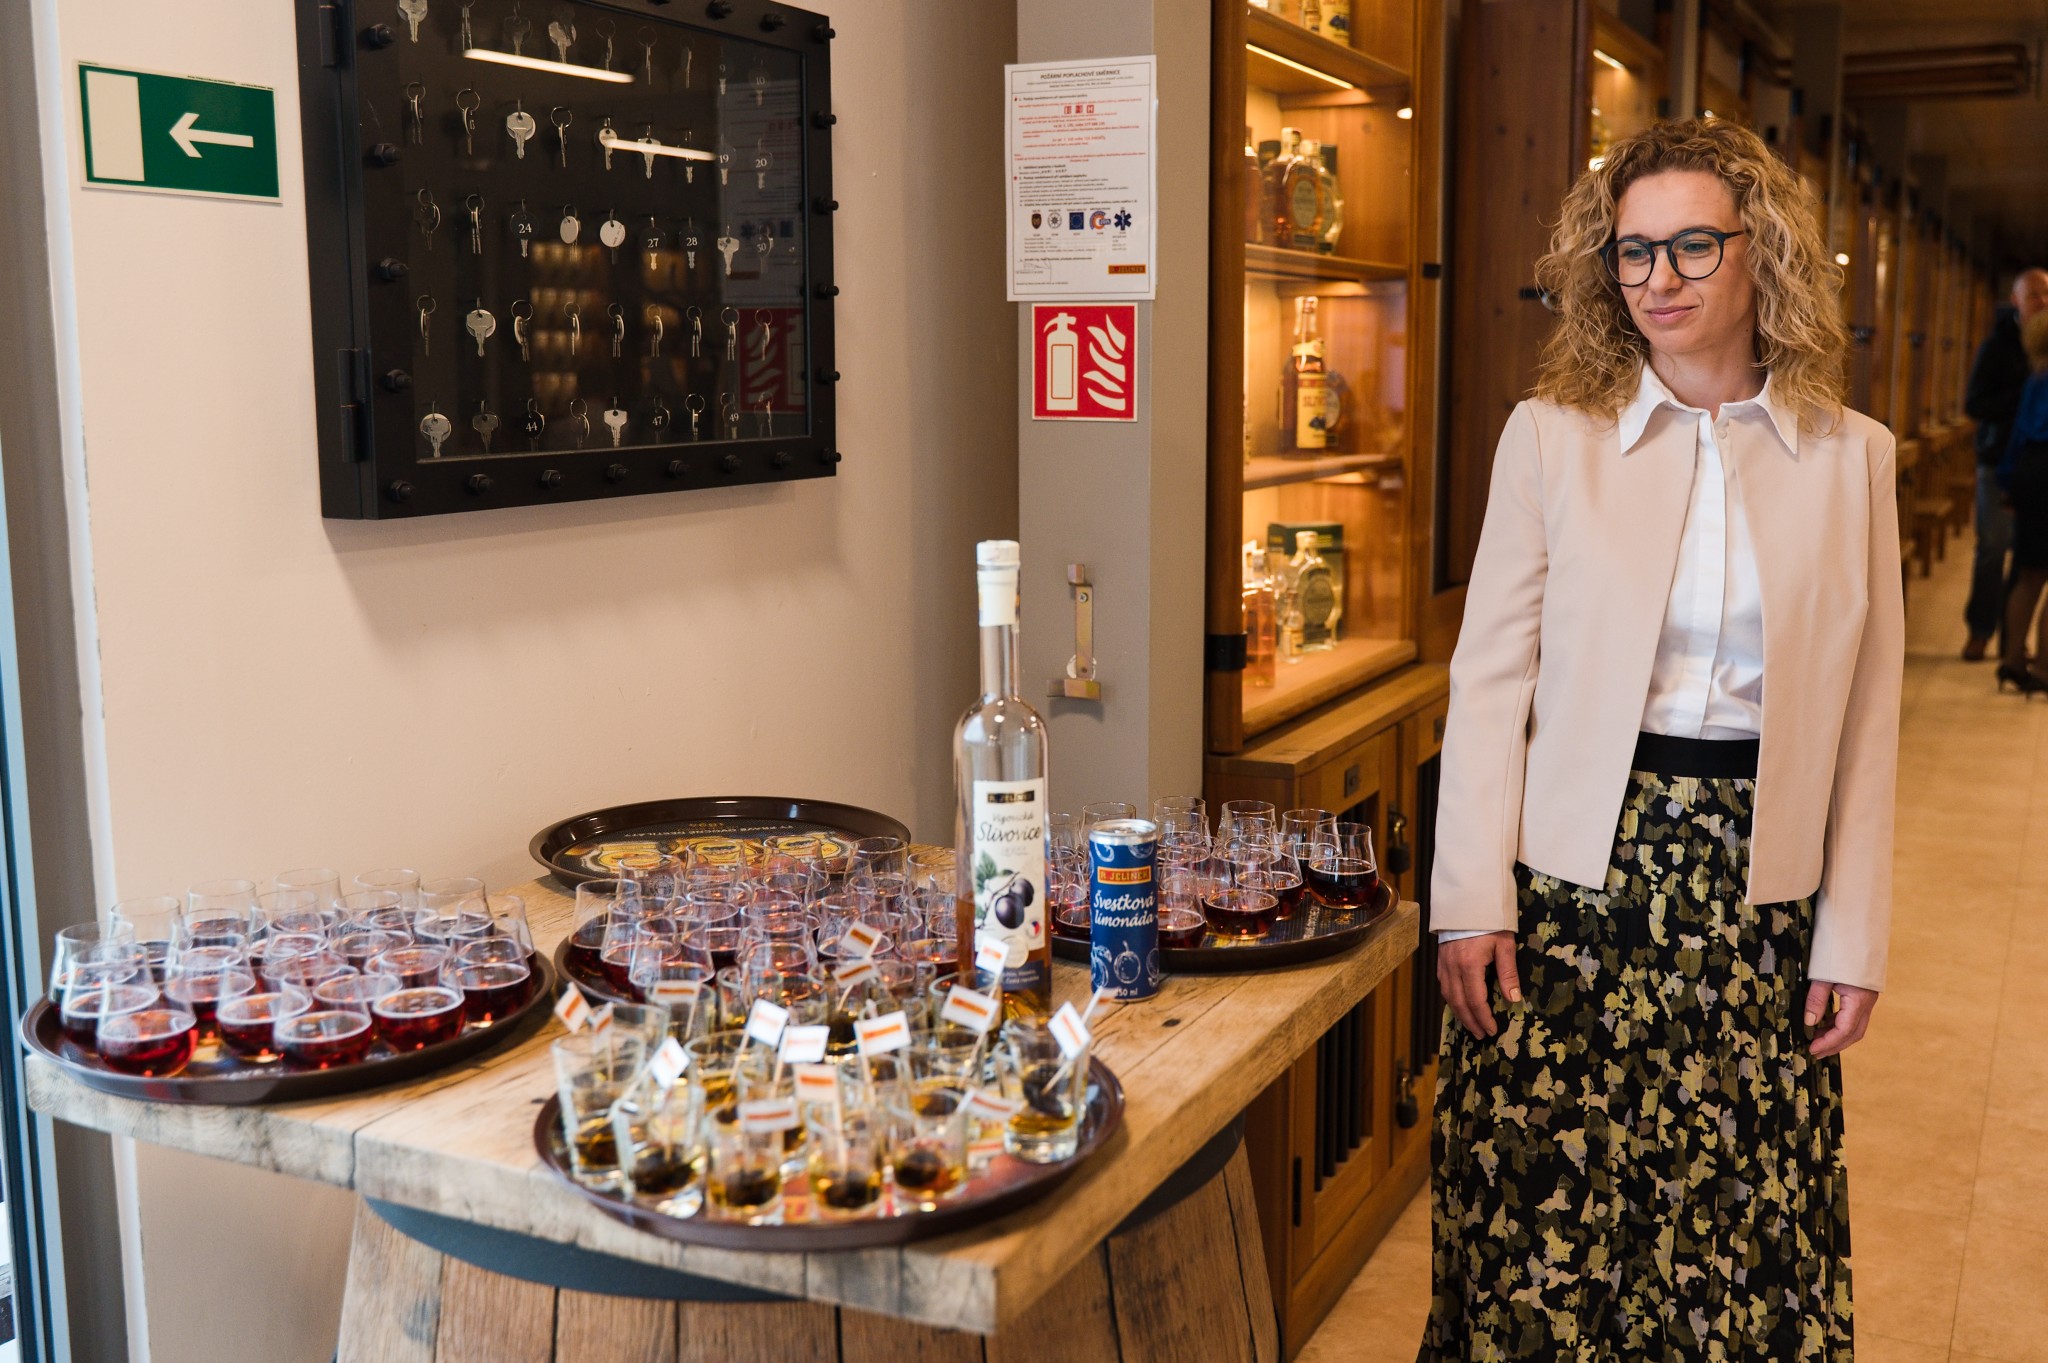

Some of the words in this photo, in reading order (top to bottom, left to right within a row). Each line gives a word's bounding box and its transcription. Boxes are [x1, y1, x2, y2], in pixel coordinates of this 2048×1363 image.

[756, 76, 766, 86] 10
[719, 154, 730, 164] 19
[755, 158, 767, 168] 20
[518, 223, 532, 234] 24
[647, 238, 659, 248] 27
[686, 237, 698, 247] 28
[652, 416, 663, 426] 47
[729, 413, 740, 422] 49
[526, 421, 538, 432] 44
[977, 821, 1041, 842] Slivovice
[1093, 890, 1155, 912] Švestková
[1094, 910, 1155, 928] limonáda
[1129, 987, 1138, 996] ml
